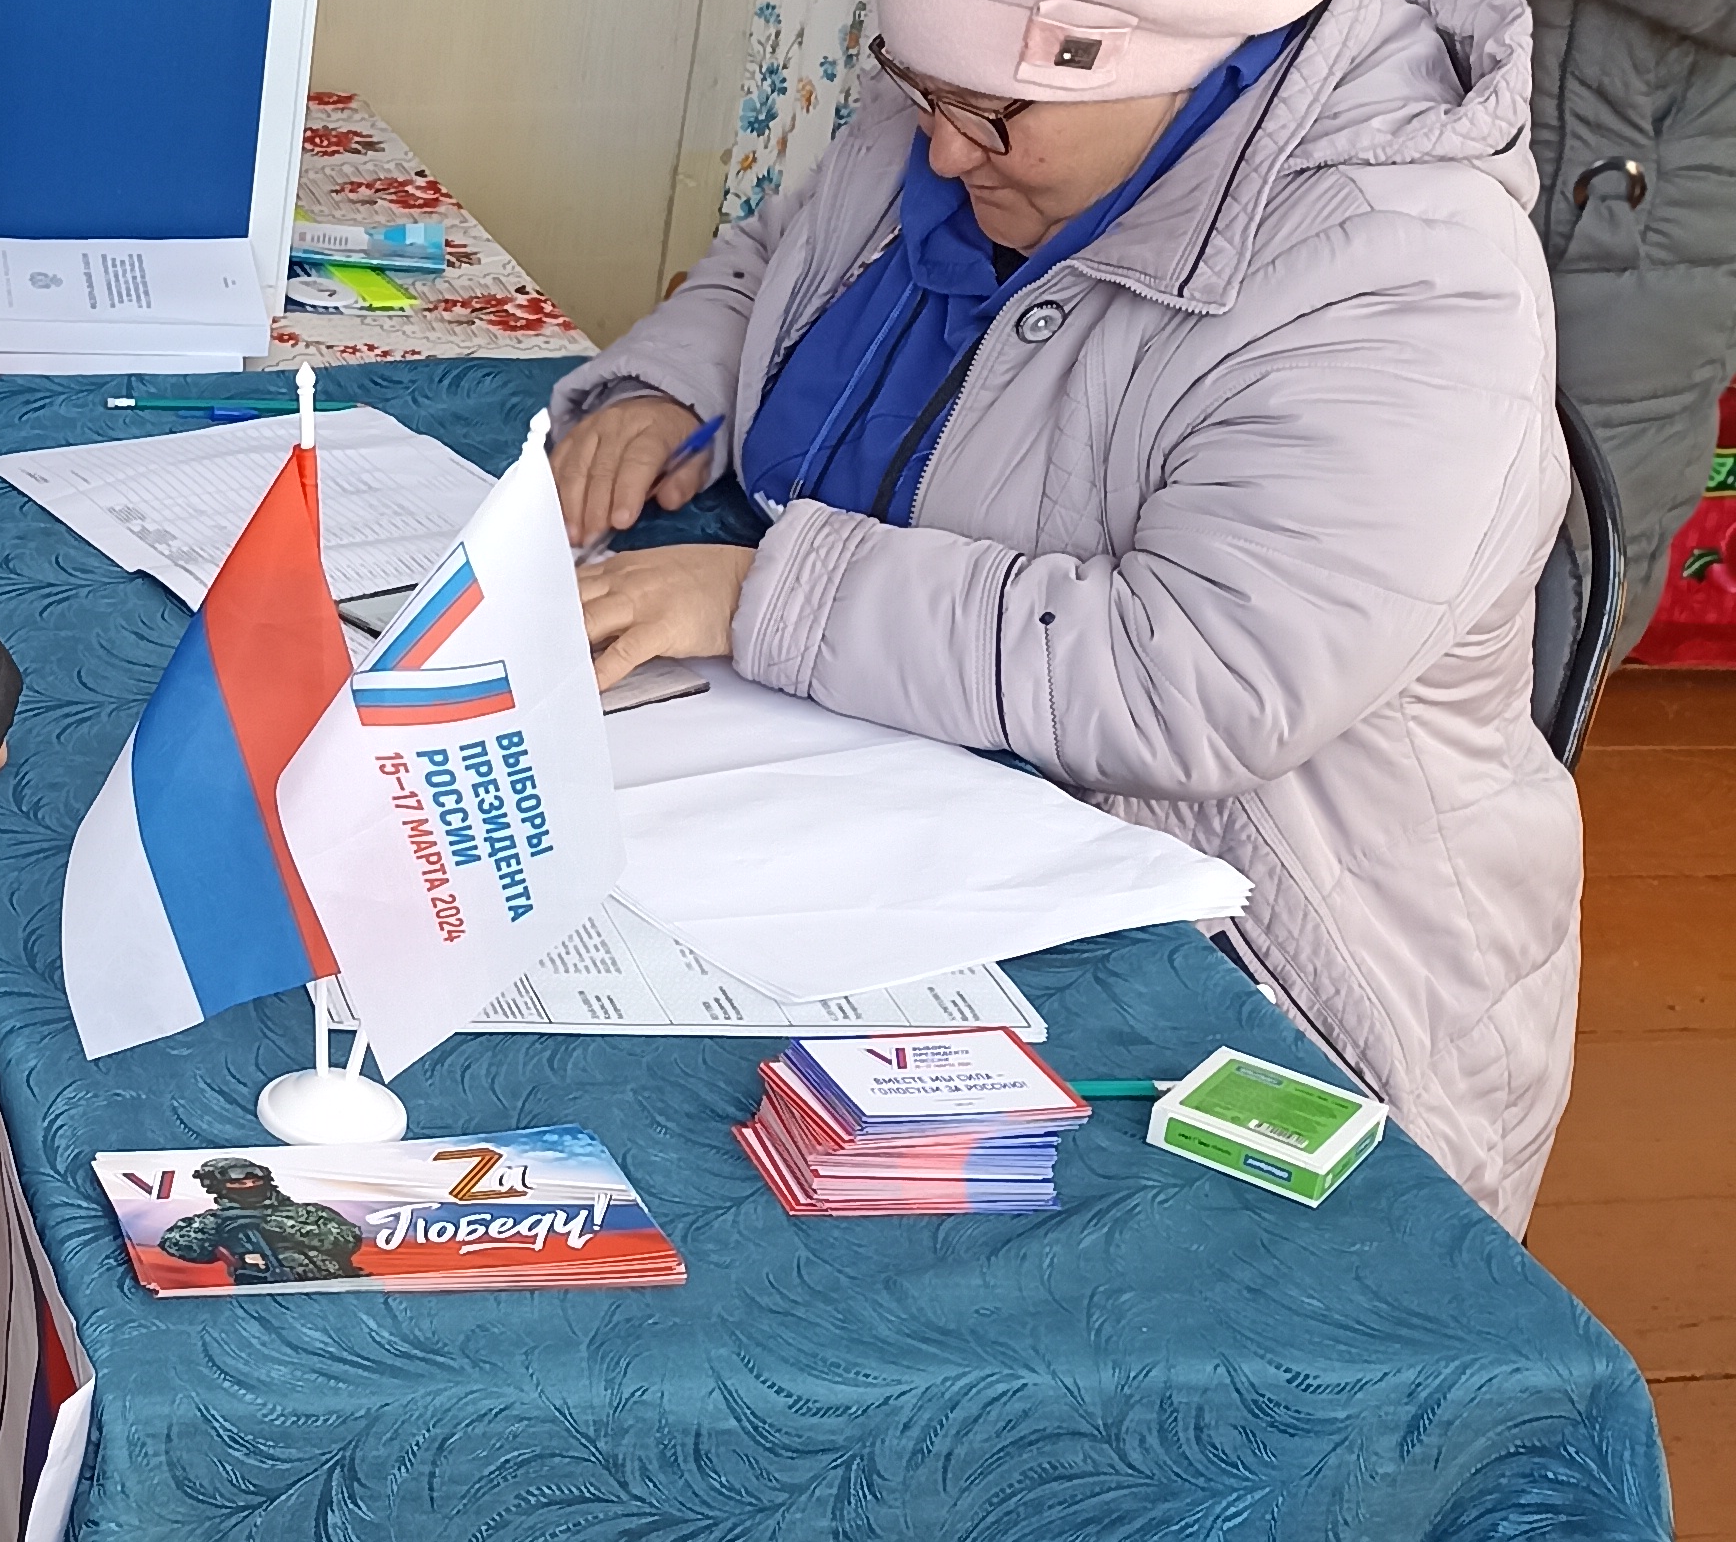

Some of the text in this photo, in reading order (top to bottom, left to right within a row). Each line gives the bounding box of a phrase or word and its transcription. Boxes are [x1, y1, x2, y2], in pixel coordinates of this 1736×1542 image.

[415, 748, 482, 867] РОССИИ
[458, 739, 534, 923] ПРЕЗИДЕНТА
[495, 730, 554, 858] ВЫБОРЫ
[401, 817, 450, 893] МАРТА
[430, 893, 467, 943] 2024
[870, 1080, 1028, 1096] ГОЛОСУЕМ ЗА РОССИЮ!
[873, 1075, 928, 1087] ВМЕСТЕ
[929, 1074, 954, 1084] МЫ
[956, 1072, 994, 1082] СИЛА
[364, 1193, 614, 1255] Победу!
